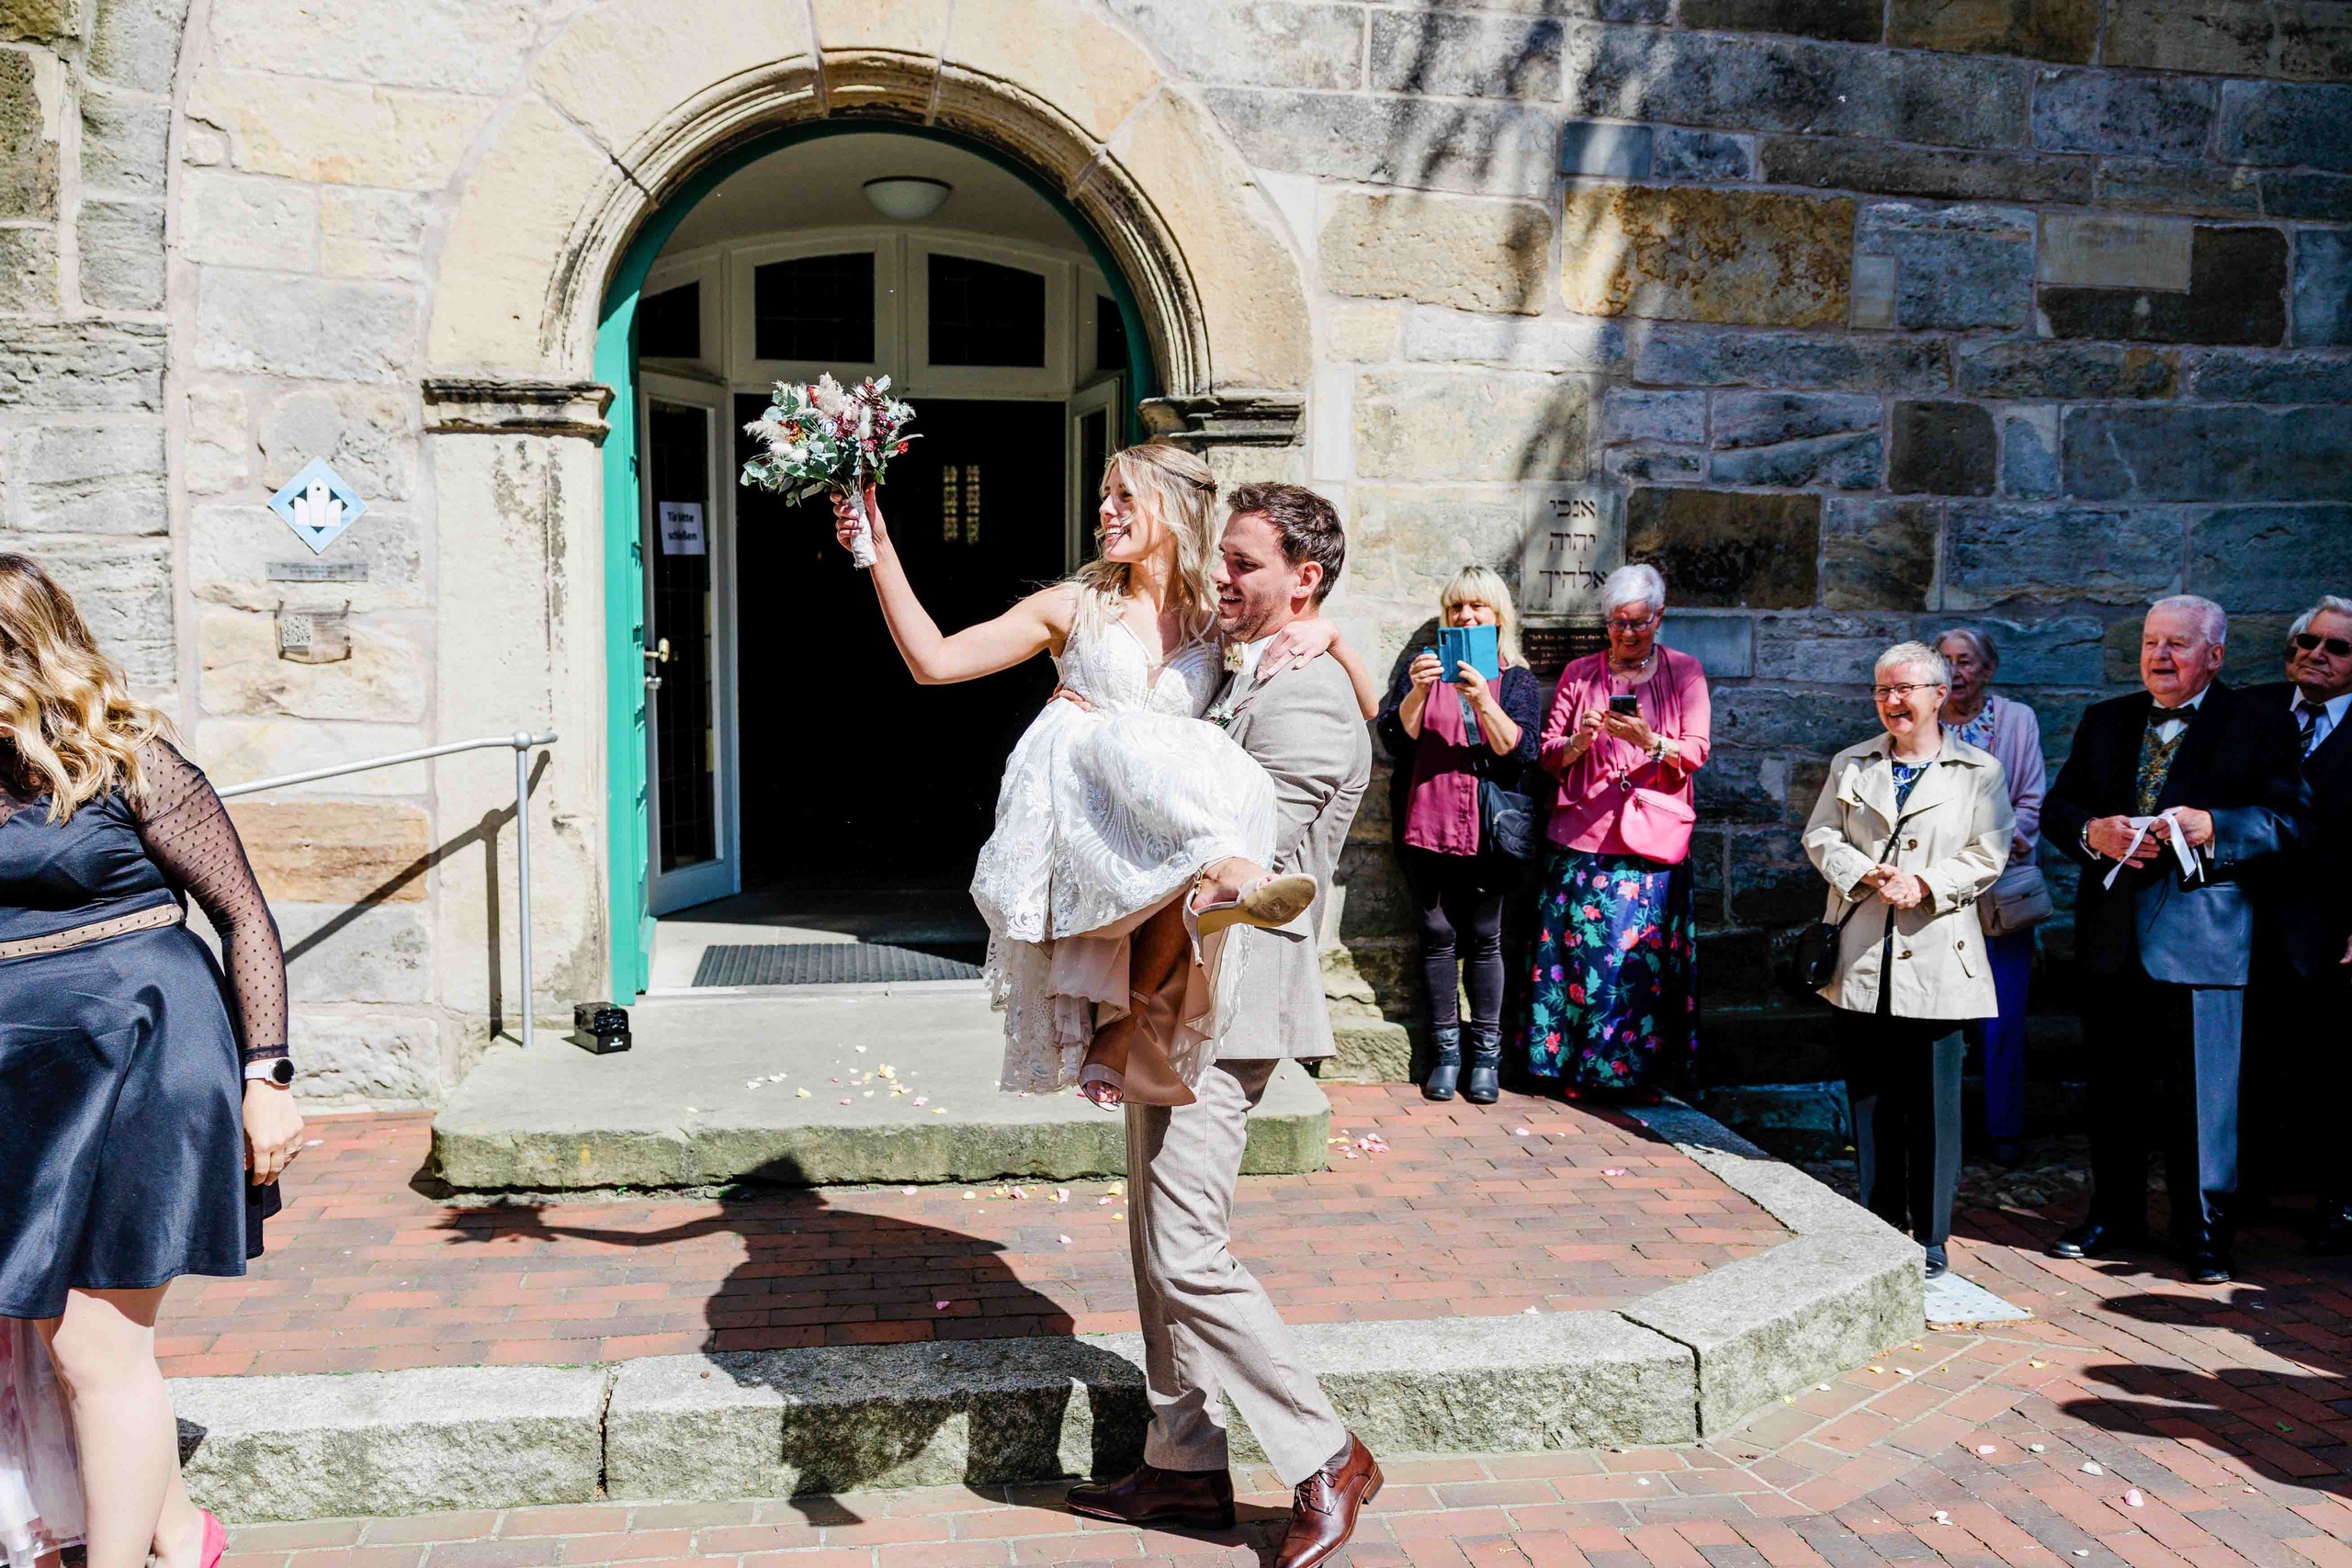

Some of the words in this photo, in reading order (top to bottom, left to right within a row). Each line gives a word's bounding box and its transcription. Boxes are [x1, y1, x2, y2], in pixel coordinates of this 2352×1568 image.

[1549, 500, 1596, 518] אנכי
[1549, 532, 1596, 551] יהוה
[1539, 560, 1608, 598] אלהיך
